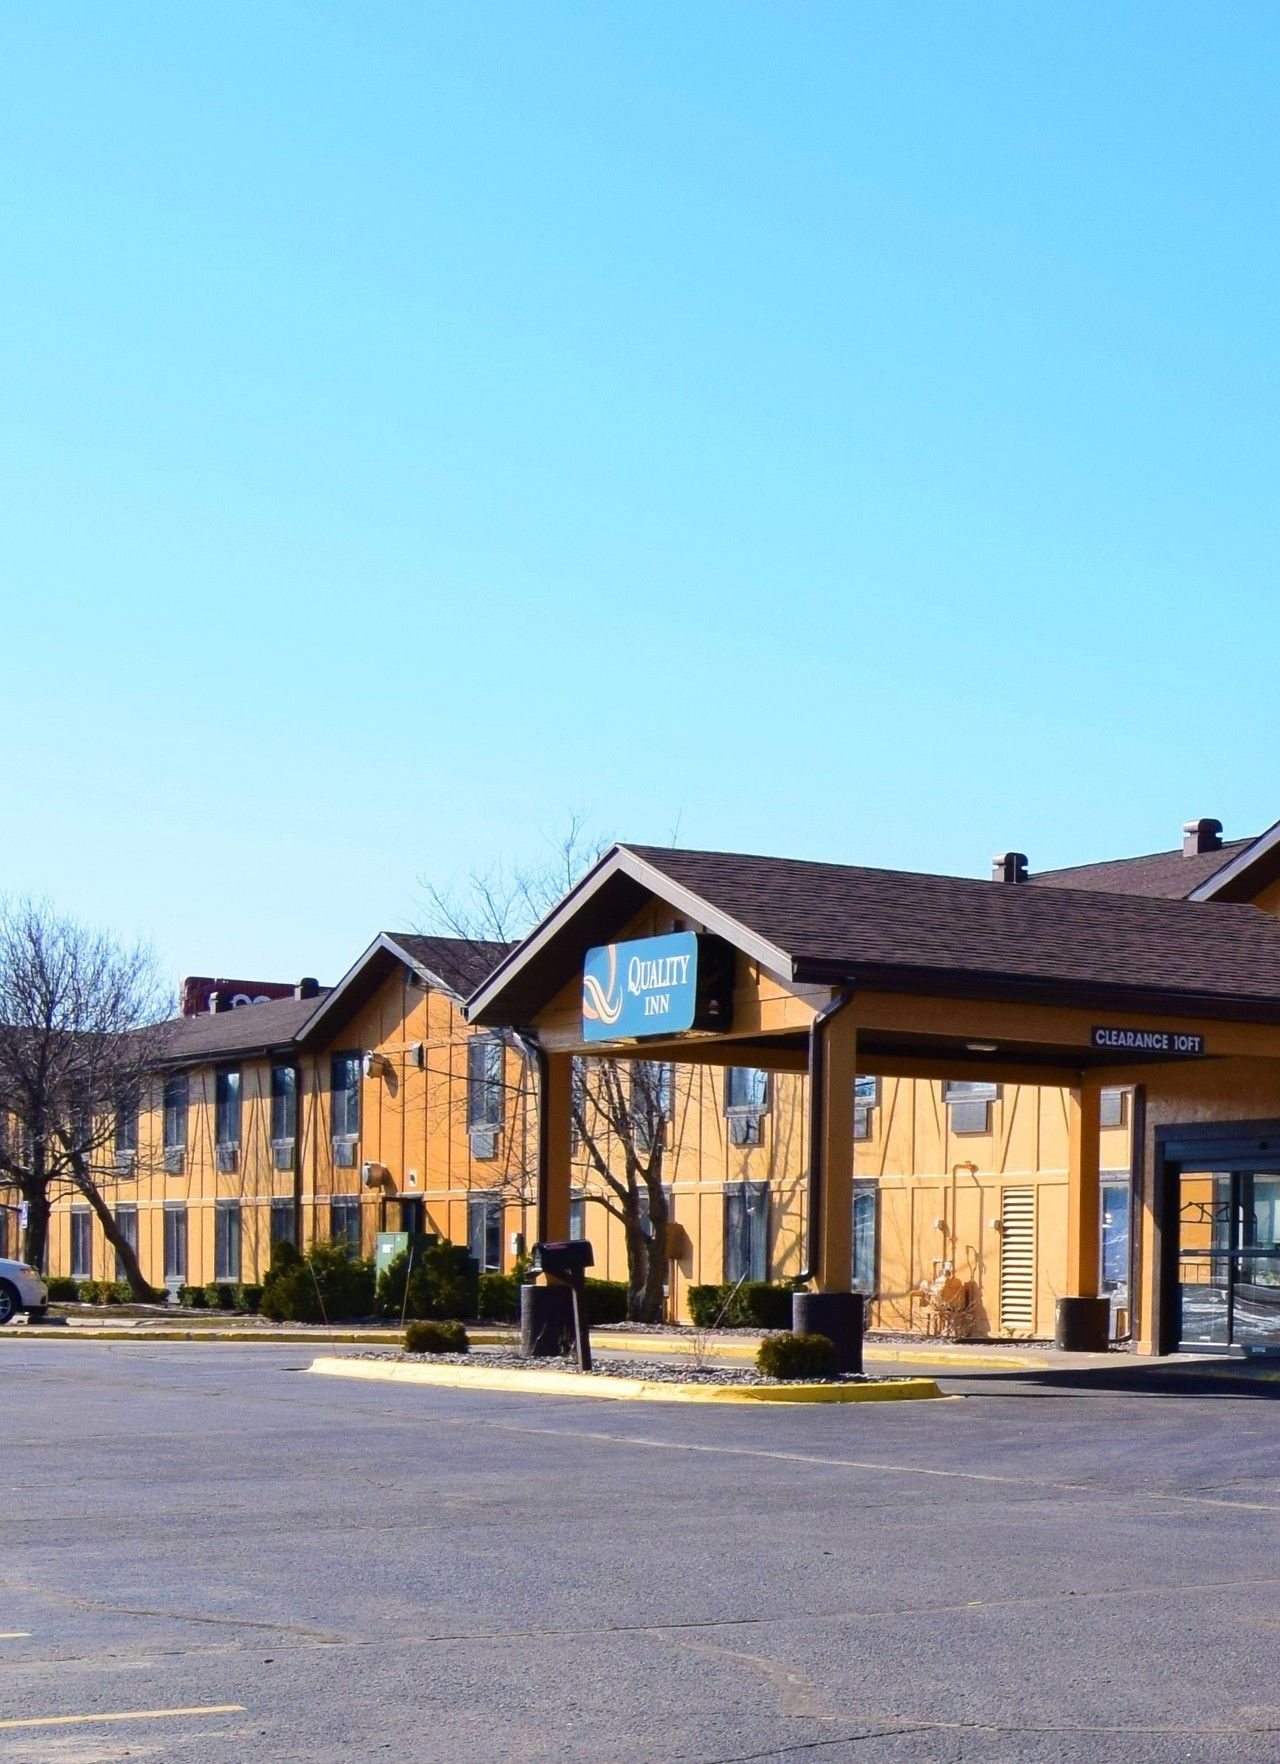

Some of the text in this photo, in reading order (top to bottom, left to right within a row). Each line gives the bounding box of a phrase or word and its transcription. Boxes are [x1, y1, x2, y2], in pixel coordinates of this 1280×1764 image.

[628, 955, 690, 996] QUALITY
[644, 994, 670, 1016] INN
[1095, 1029, 1201, 1051] CLEARANCE 10FT
